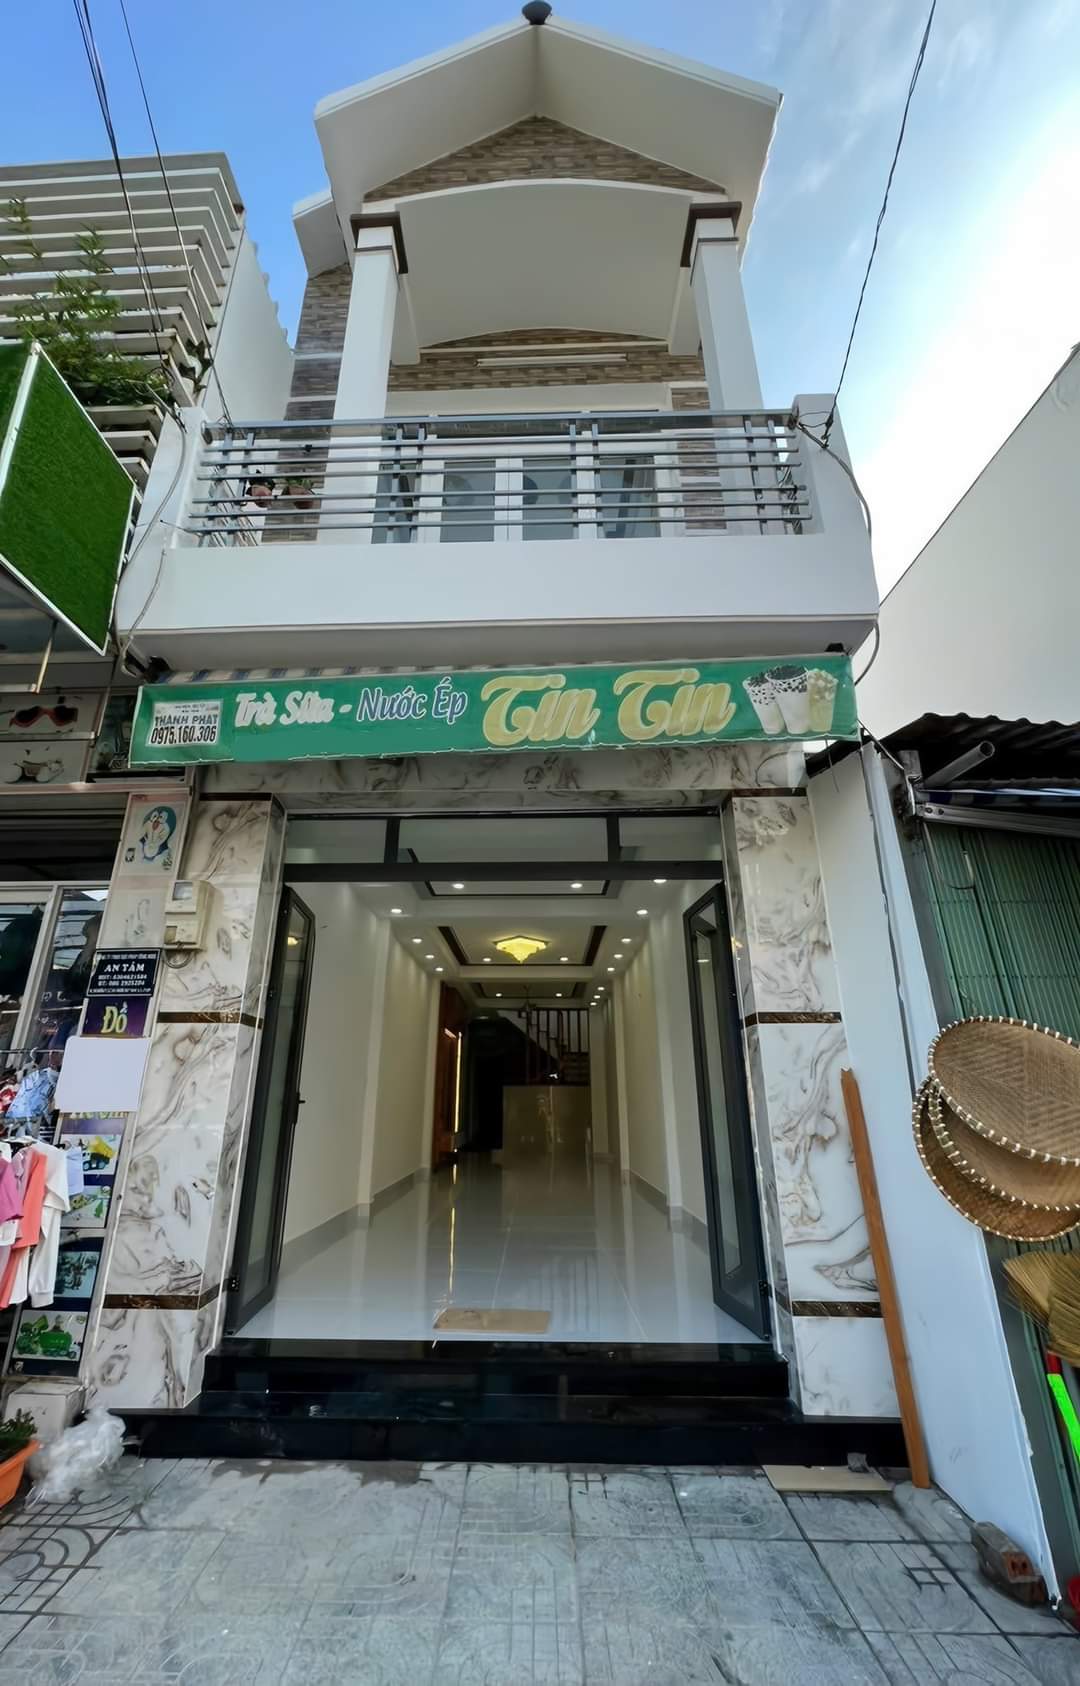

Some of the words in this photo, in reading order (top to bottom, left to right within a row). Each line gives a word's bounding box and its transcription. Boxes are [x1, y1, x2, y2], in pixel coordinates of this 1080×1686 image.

[235, 691, 277, 727] Trà
[356, 685, 428, 722] Nước
[432, 676, 468, 725] Ép
[481, 674, 601, 746] Tin
[613, 668, 736, 740] Tin
[150, 725, 217, 744] 0975.160.306
